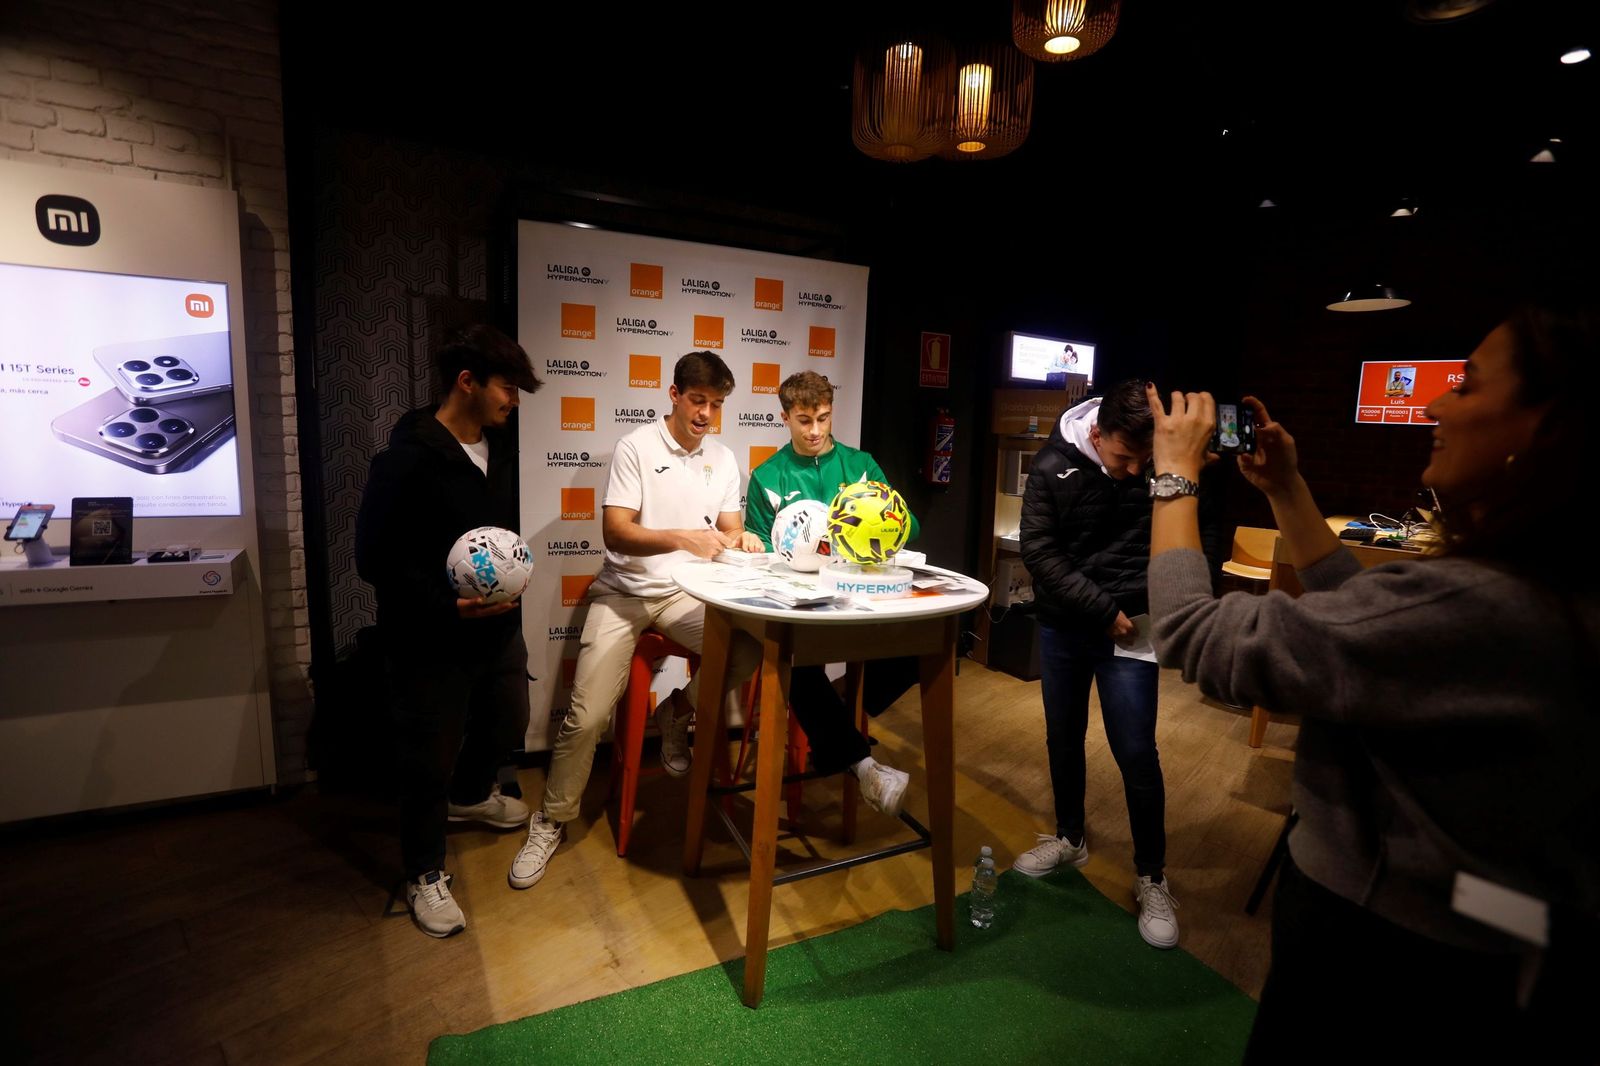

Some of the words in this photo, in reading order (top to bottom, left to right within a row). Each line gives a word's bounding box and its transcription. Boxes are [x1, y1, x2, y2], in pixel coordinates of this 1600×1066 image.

[547, 264, 579, 275] LALIGA
[547, 273, 604, 285] HYPERMOTION
[682, 278, 710, 289] LALIGA
[631, 288, 660, 298] orange
[682, 288, 731, 298] HYPERMOTION
[798, 292, 823, 302] LALIGA
[755, 301, 780, 310] orange
[617, 318, 646, 328] LALIGA
[563, 328, 592, 338] orange
[617, 327, 669, 336] HYPERMOTION
[741, 328, 768, 338] LALIGA
[695, 339, 721, 348] orange
[741, 337, 787, 346] HYPERMOTION
[809, 348, 833, 357] orange
[9, 363, 31, 373] 15T
[36, 365, 75, 375] Series
[547, 360, 579, 369] LALIGA
[547, 369, 602, 377] HYPERMOTION
[1447, 373, 1465, 383] RS
[630, 379, 658, 388] orange
[753, 385, 777, 394] orange
[615, 408, 645, 417] LALIGA
[739, 413, 765, 421] LALIGA
[563, 422, 592, 430] orange
[547, 452, 578, 461] LALIGA
[563, 512, 591, 520] orange
[548, 541, 579, 550] LALIGA
